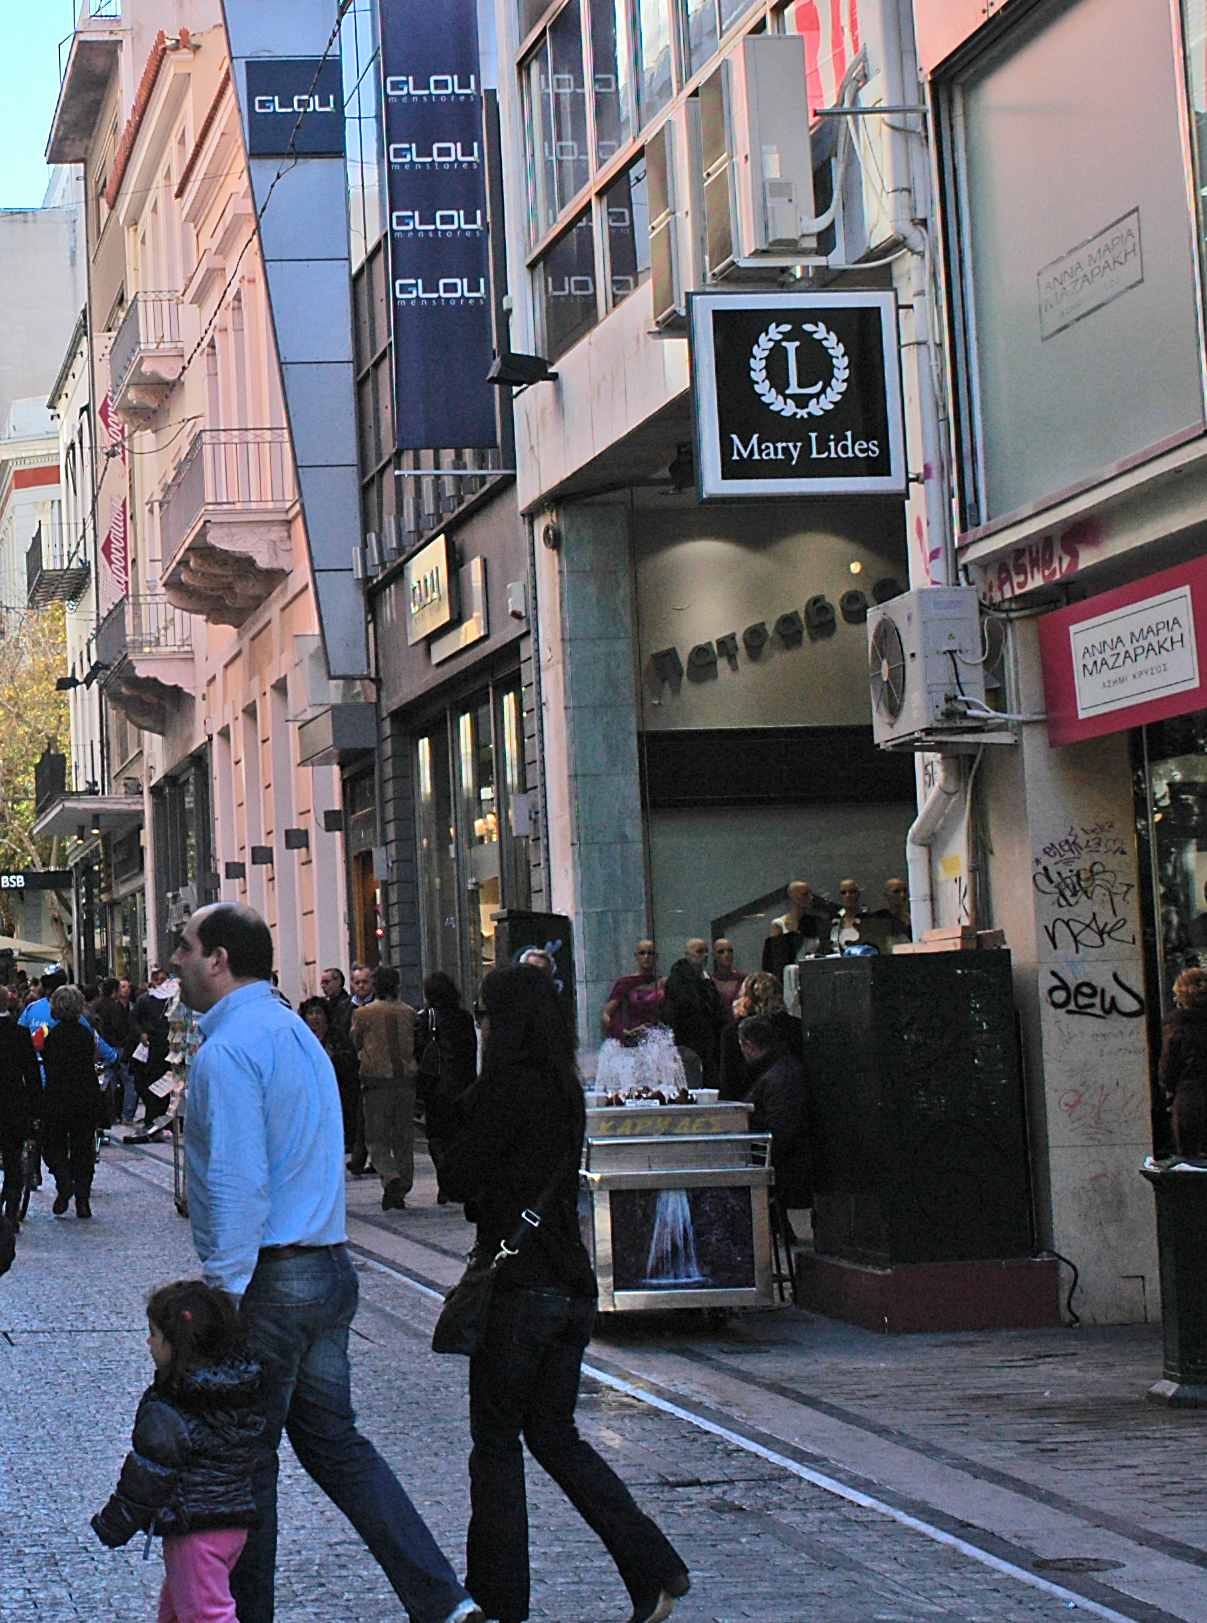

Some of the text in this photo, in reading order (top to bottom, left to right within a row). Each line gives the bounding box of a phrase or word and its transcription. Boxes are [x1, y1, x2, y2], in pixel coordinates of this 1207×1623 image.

[386, 74, 476, 95] GLOU
[254, 94, 335, 113] GLOU
[389, 141, 479, 162] GLOU
[392, 209, 483, 231] GLOU
[395, 277, 486, 299] GLOU
[780, 341, 823, 395] L
[730, 430, 880, 466] Mary Lides
[1, 875, 25, 888] BSB
